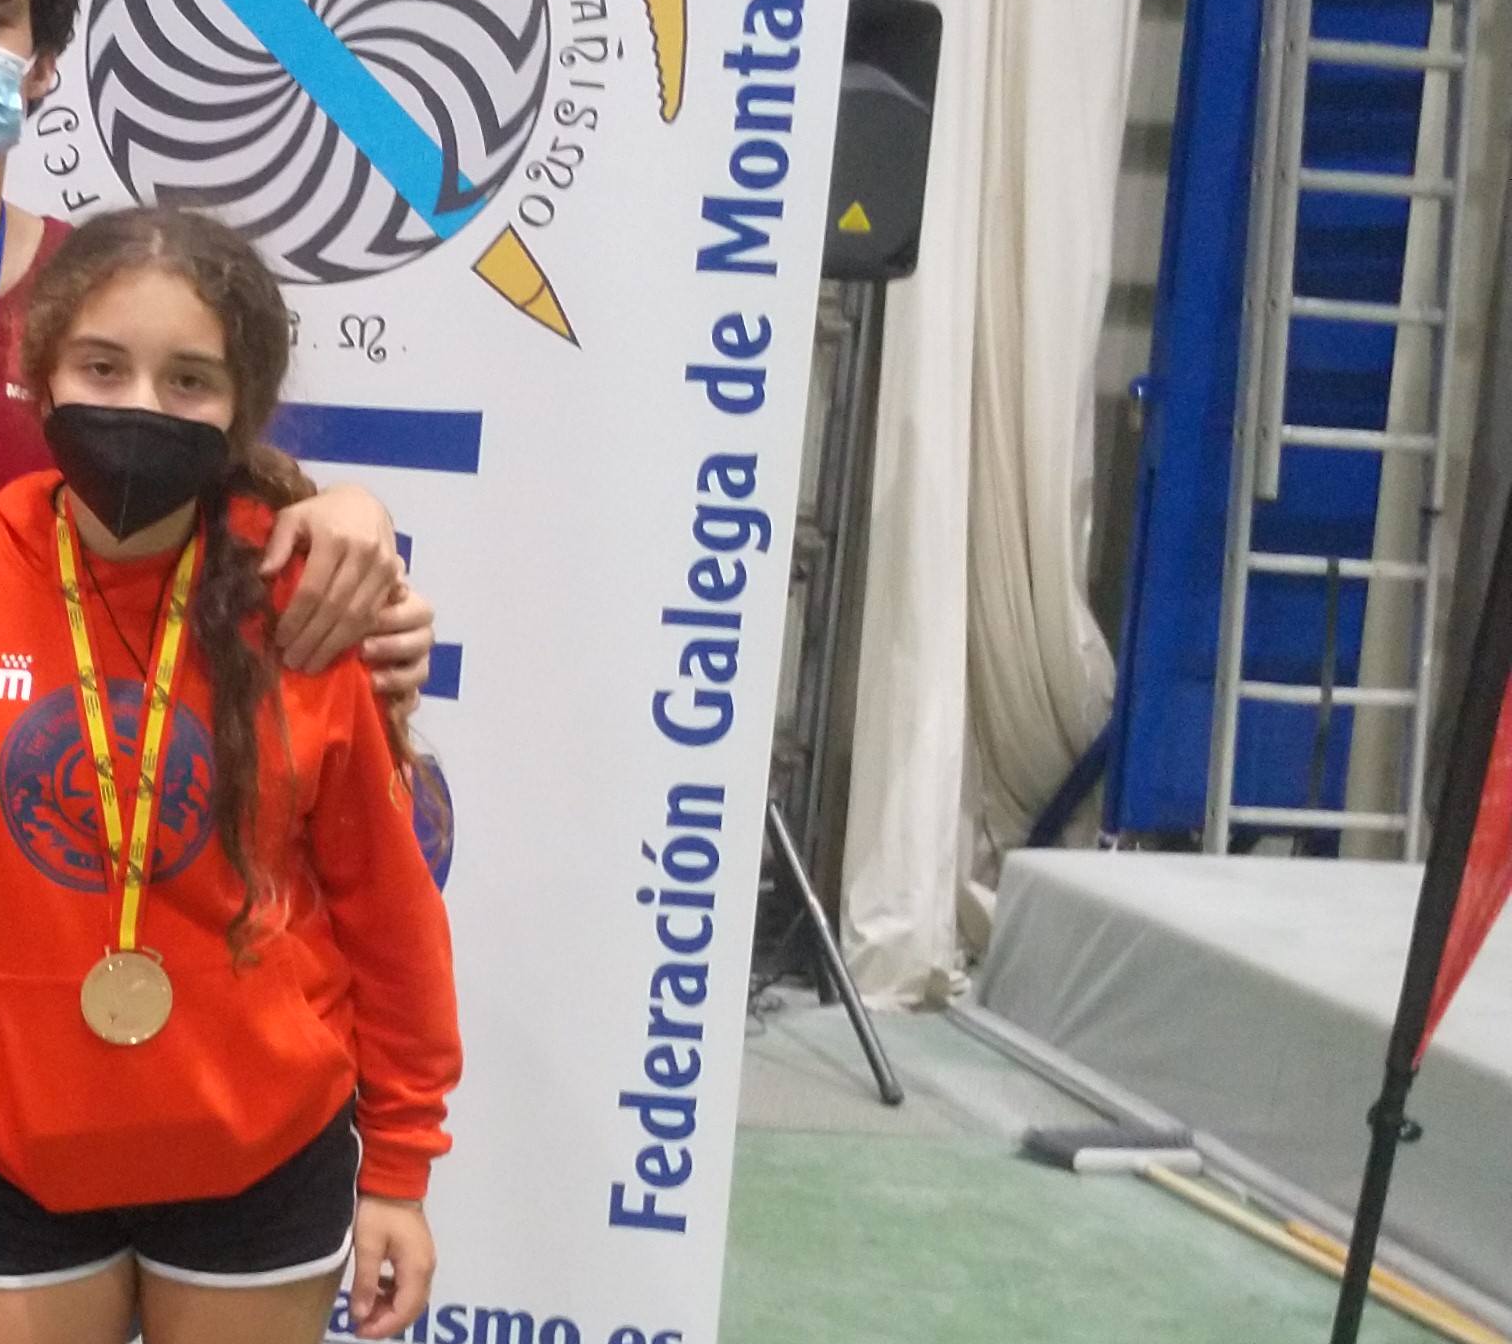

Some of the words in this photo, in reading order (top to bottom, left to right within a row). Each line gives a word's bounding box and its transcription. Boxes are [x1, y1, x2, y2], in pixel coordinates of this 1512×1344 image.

[685, 311, 772, 416] de
[651, 451, 773, 747] Galega
[608, 782, 725, 1234] Federación
